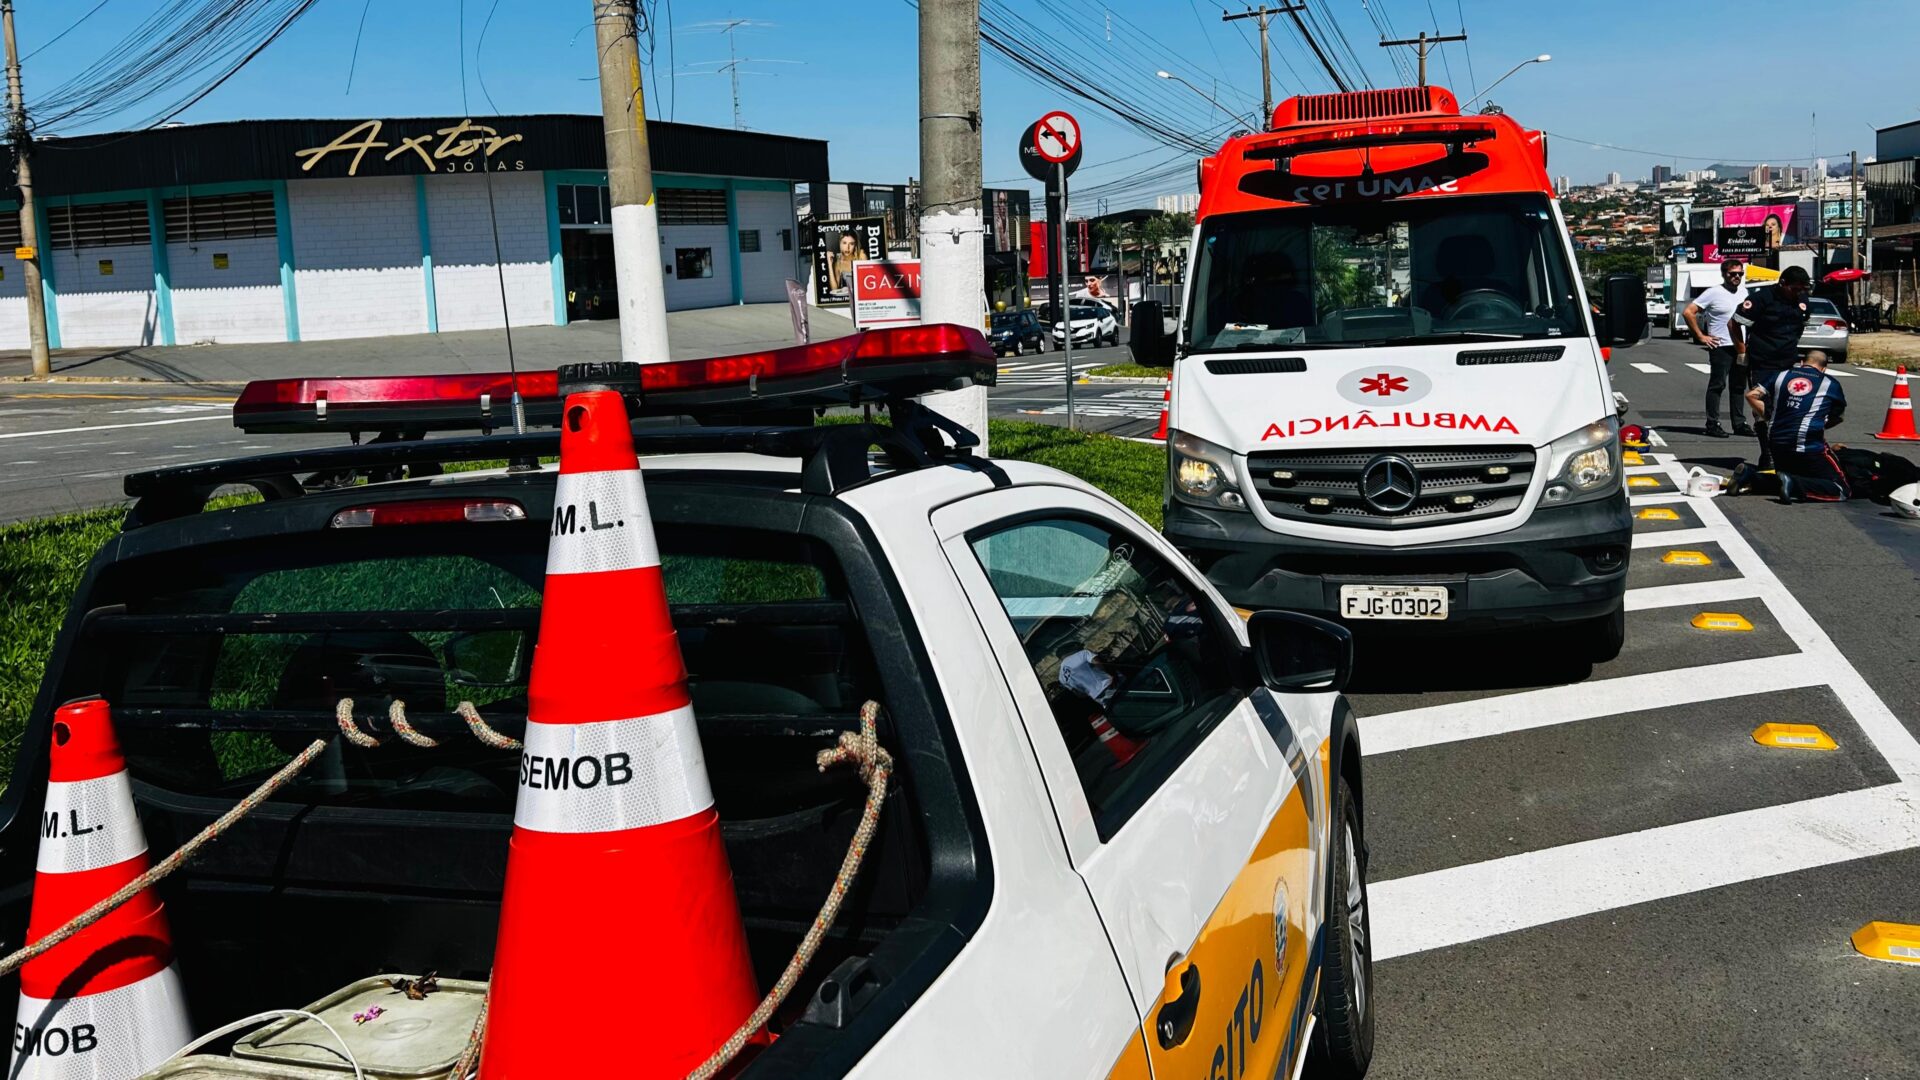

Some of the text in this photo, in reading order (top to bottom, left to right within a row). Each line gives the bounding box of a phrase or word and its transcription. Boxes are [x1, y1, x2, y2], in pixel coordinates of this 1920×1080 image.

[295, 119, 523, 176] Axtor
[446, 158, 525, 173] JÓIAS
[817, 224, 850, 234] Serviços
[867, 225, 883, 260] Ban
[818, 238, 828, 294] Axtor
[520, 752, 633, 790] SEMOB
[42, 809, 103, 839] M.L.
